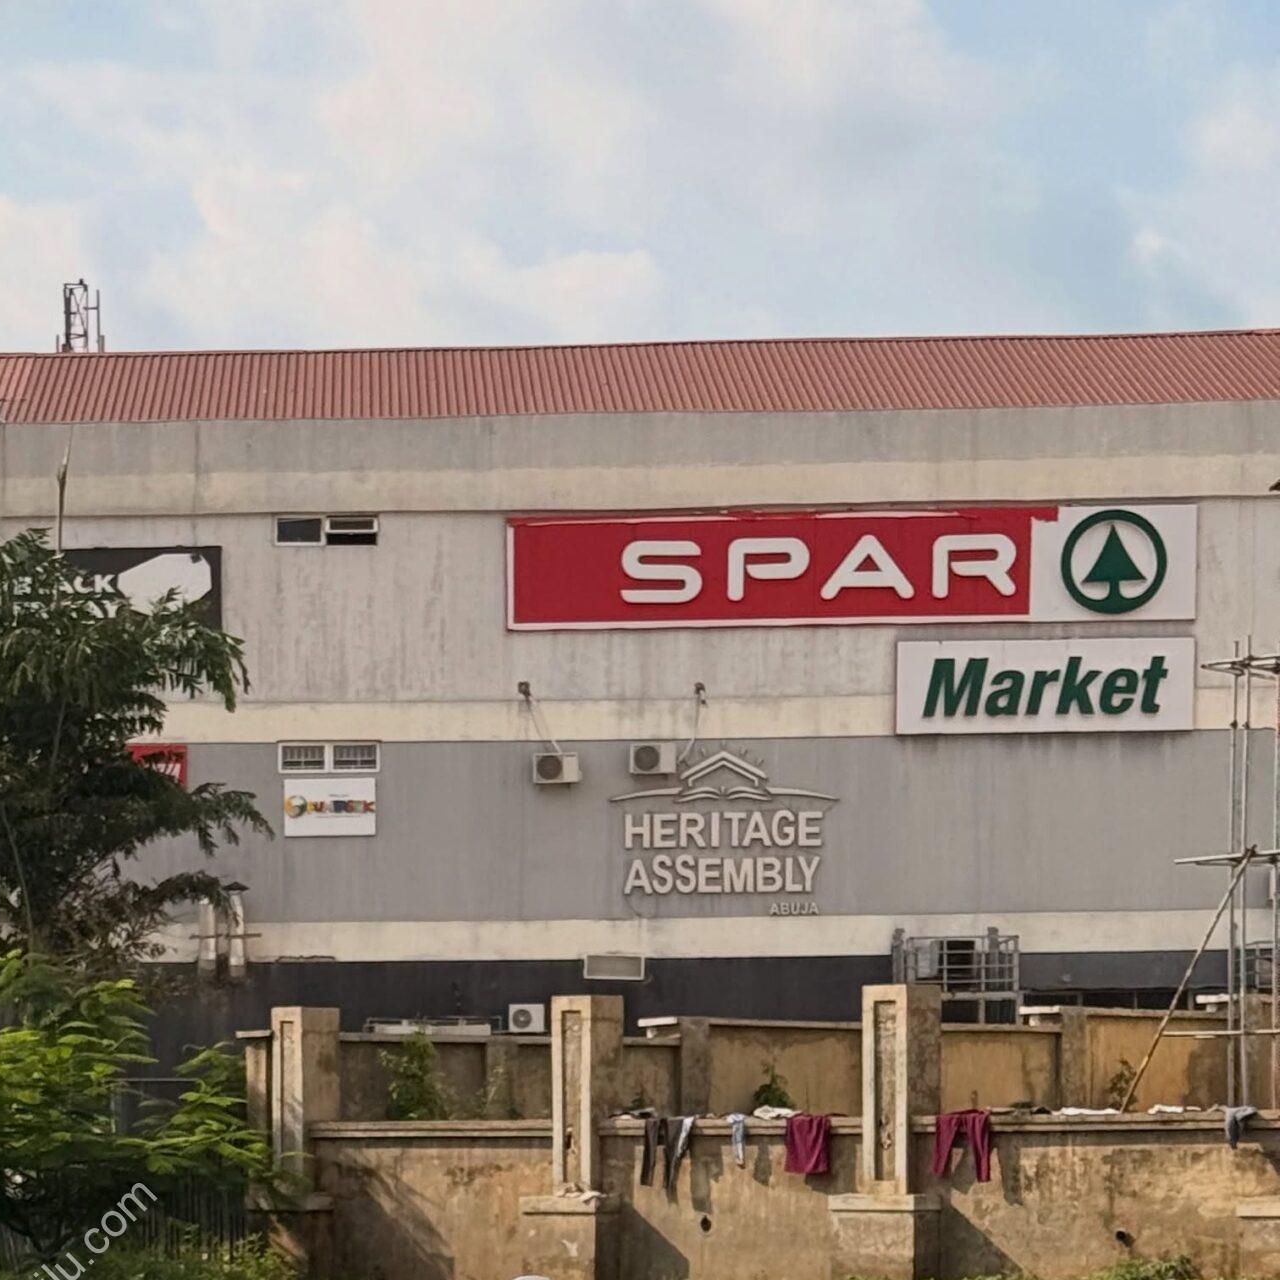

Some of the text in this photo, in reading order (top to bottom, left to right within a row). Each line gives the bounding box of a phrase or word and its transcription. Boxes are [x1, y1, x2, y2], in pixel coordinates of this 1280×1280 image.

[620, 534, 1017, 604] SPAR
[921, 655, 1169, 717] Market
[624, 809, 824, 849] HERITAGE
[623, 853, 821, 895] ASSEMBLY
[769, 901, 820, 916] ABUJA
